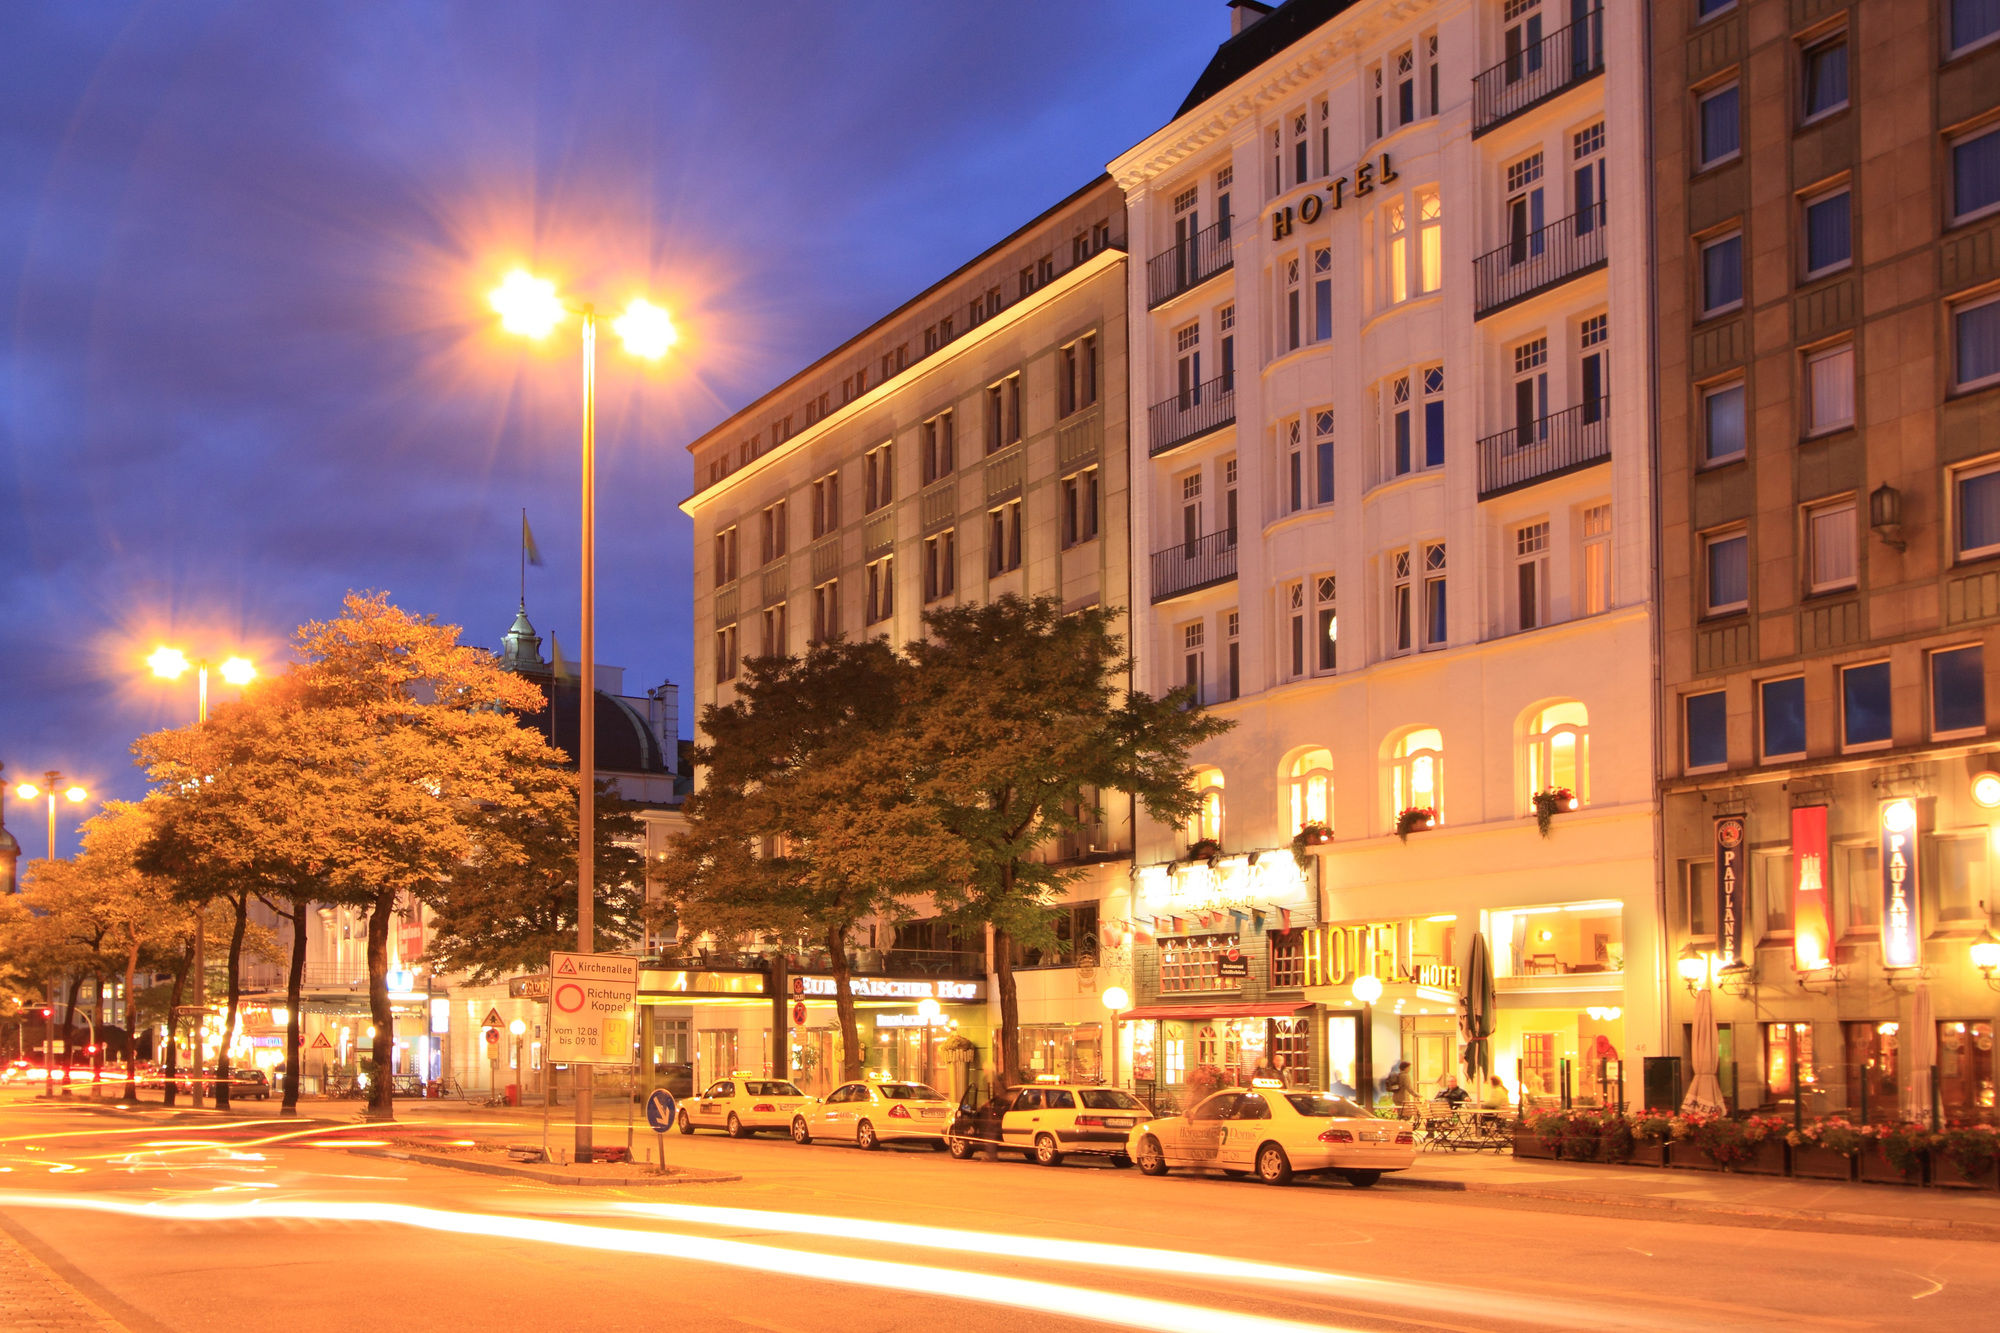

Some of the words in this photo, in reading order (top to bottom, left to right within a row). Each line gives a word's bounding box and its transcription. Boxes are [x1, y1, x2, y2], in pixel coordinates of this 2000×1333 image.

[1272, 153, 1398, 241] HOTEL
[1723, 850, 1736, 965] PAULANER
[1889, 836, 1910, 960] PAULANE
[1303, 922, 1410, 986] HOTEL
[578, 961, 633, 975] Kirchenallee
[1419, 964, 1462, 988] HOTEL
[587, 988, 632, 1002] Richtung
[591, 1001, 627, 1013] Koppel
[559, 1036, 572, 1045] bis
